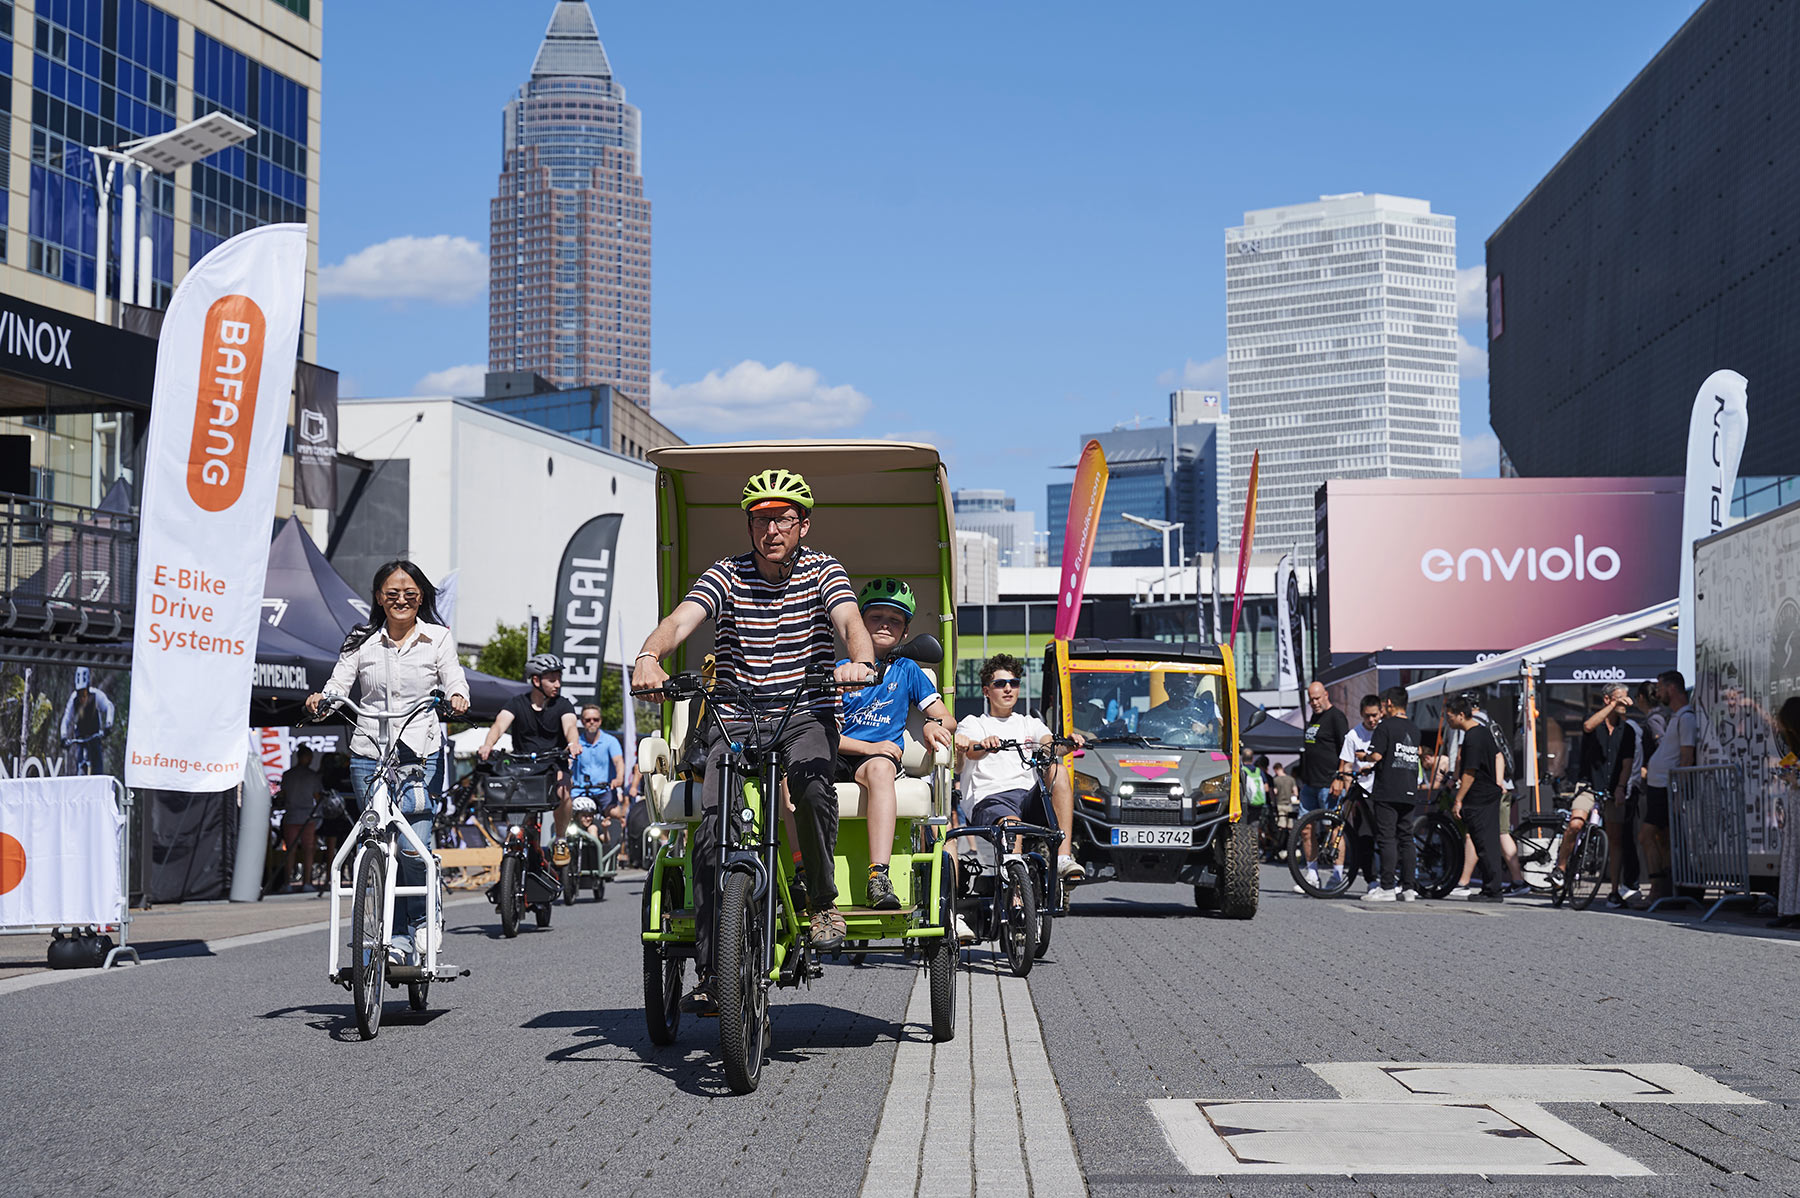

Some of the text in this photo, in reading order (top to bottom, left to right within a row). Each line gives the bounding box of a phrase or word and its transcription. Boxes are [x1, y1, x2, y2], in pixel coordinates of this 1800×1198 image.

[1421, 534, 1621, 582] enviolo
[154, 565, 227, 596] E-Bike
[150, 594, 214, 623] Drive
[148, 623, 245, 656] Systems
[1572, 666, 1626, 681] enviolo
[131, 751, 239, 773] bafang-e.com
[1120, 830, 1129, 843] B
[1157, 831, 1190, 844] 3742
